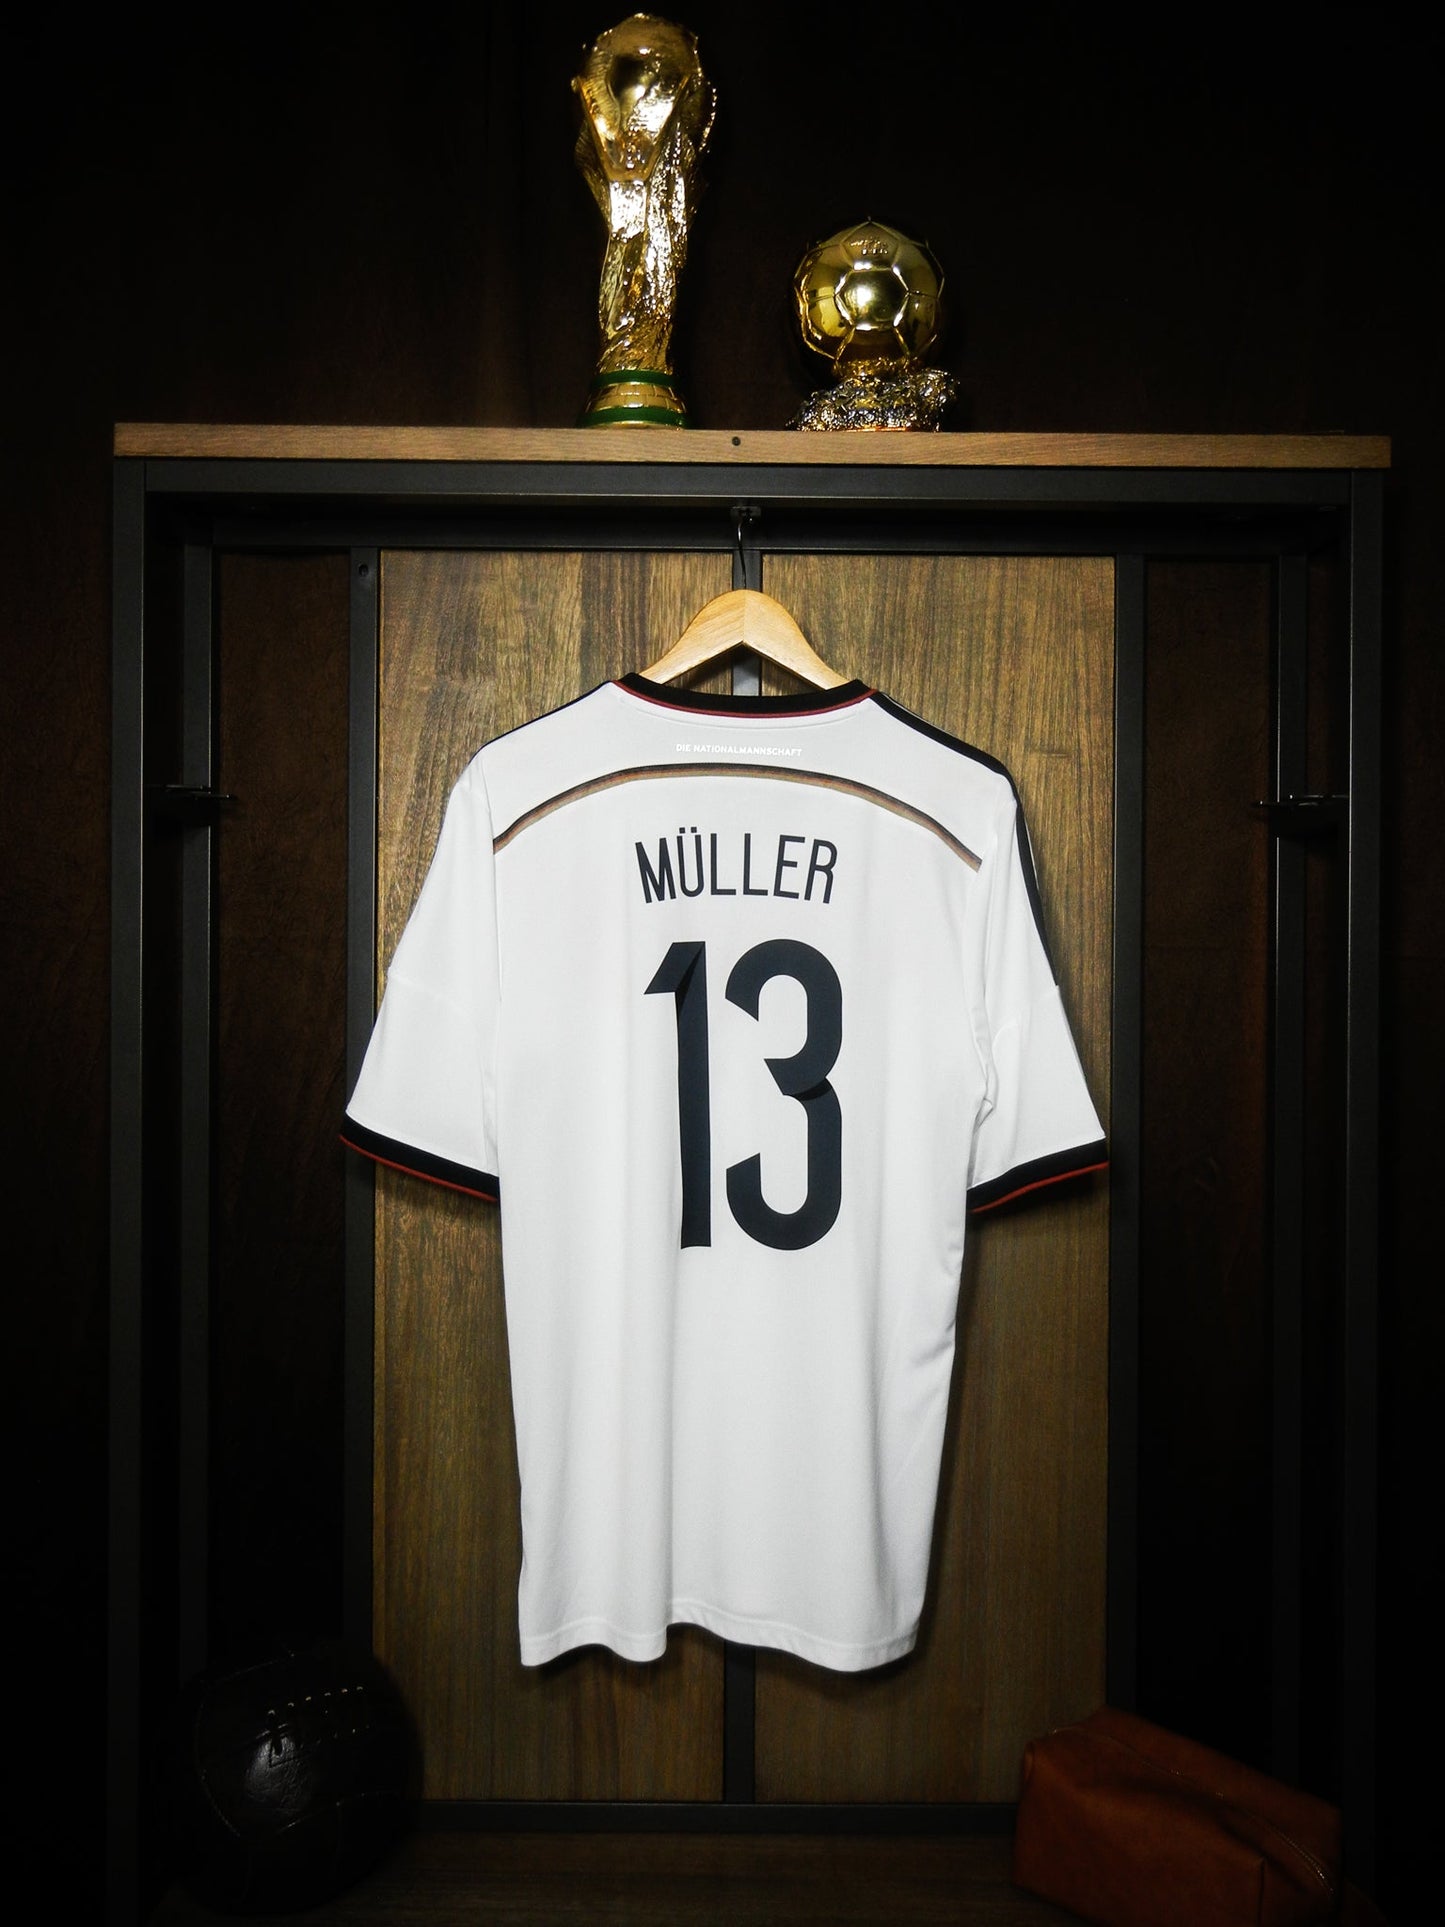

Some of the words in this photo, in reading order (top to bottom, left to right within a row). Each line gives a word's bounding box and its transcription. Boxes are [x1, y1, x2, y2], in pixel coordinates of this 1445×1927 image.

[676, 743, 691, 753] DIE
[693, 744, 803, 757] NATIONALMANNSCHAFT
[635, 826, 838, 905] MÜLLER
[643, 938, 843, 1251] 13
